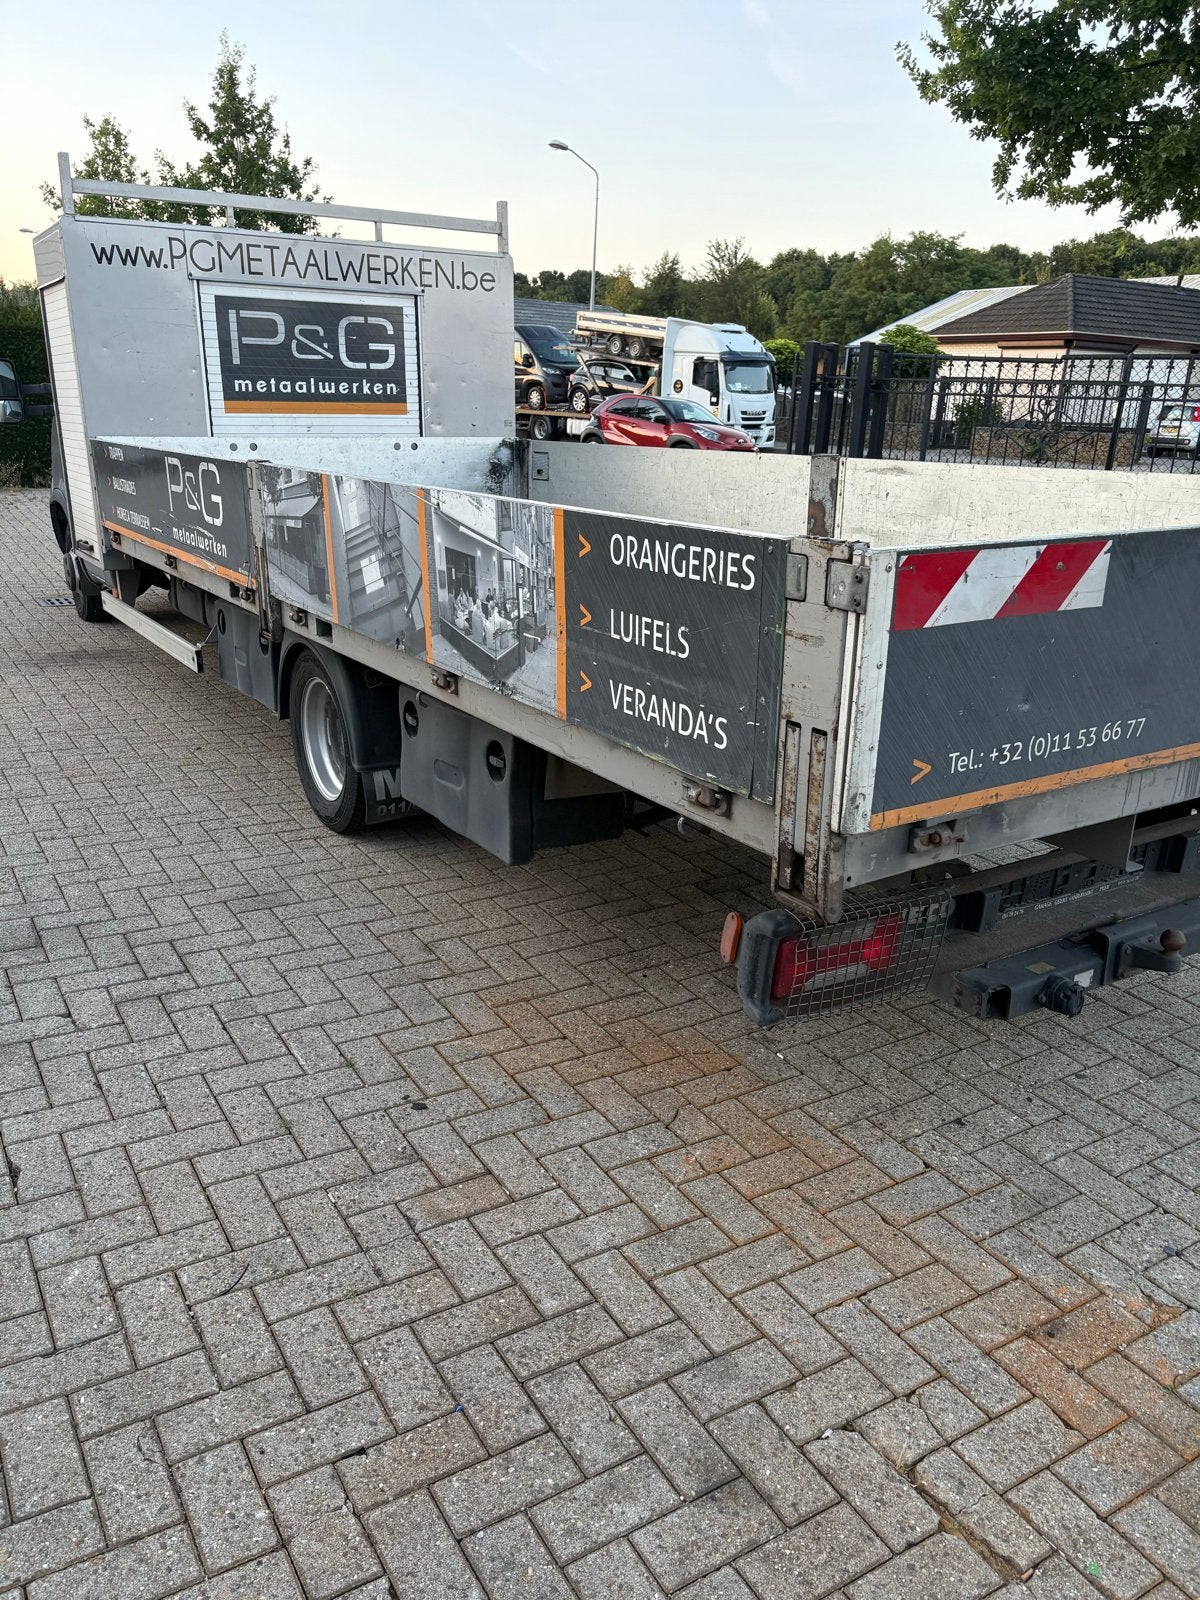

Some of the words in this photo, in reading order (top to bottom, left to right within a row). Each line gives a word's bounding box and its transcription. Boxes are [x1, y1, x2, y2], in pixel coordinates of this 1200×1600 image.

[91, 237, 495, 293] www.PGMETAALWERKEN.be
[228, 309, 396, 370] P&G
[234, 376, 398, 395] metaalwerken
[165, 456, 223, 527] P&G
[172, 526, 228, 558] metaalwerken
[609, 533, 756, 591] ORANGERIES
[610, 608, 690, 659] LUIFELS
[609, 679, 728, 750] VERANDA'S
[949, 748, 984, 774] Tel.:
[989, 741, 1023, 766] +32
[1028, 732, 1071, 762] (0)11
[1076, 726, 1098, 749] 53
[1102, 720, 1122, 743] 66
[1127, 717, 1146, 739] 77
